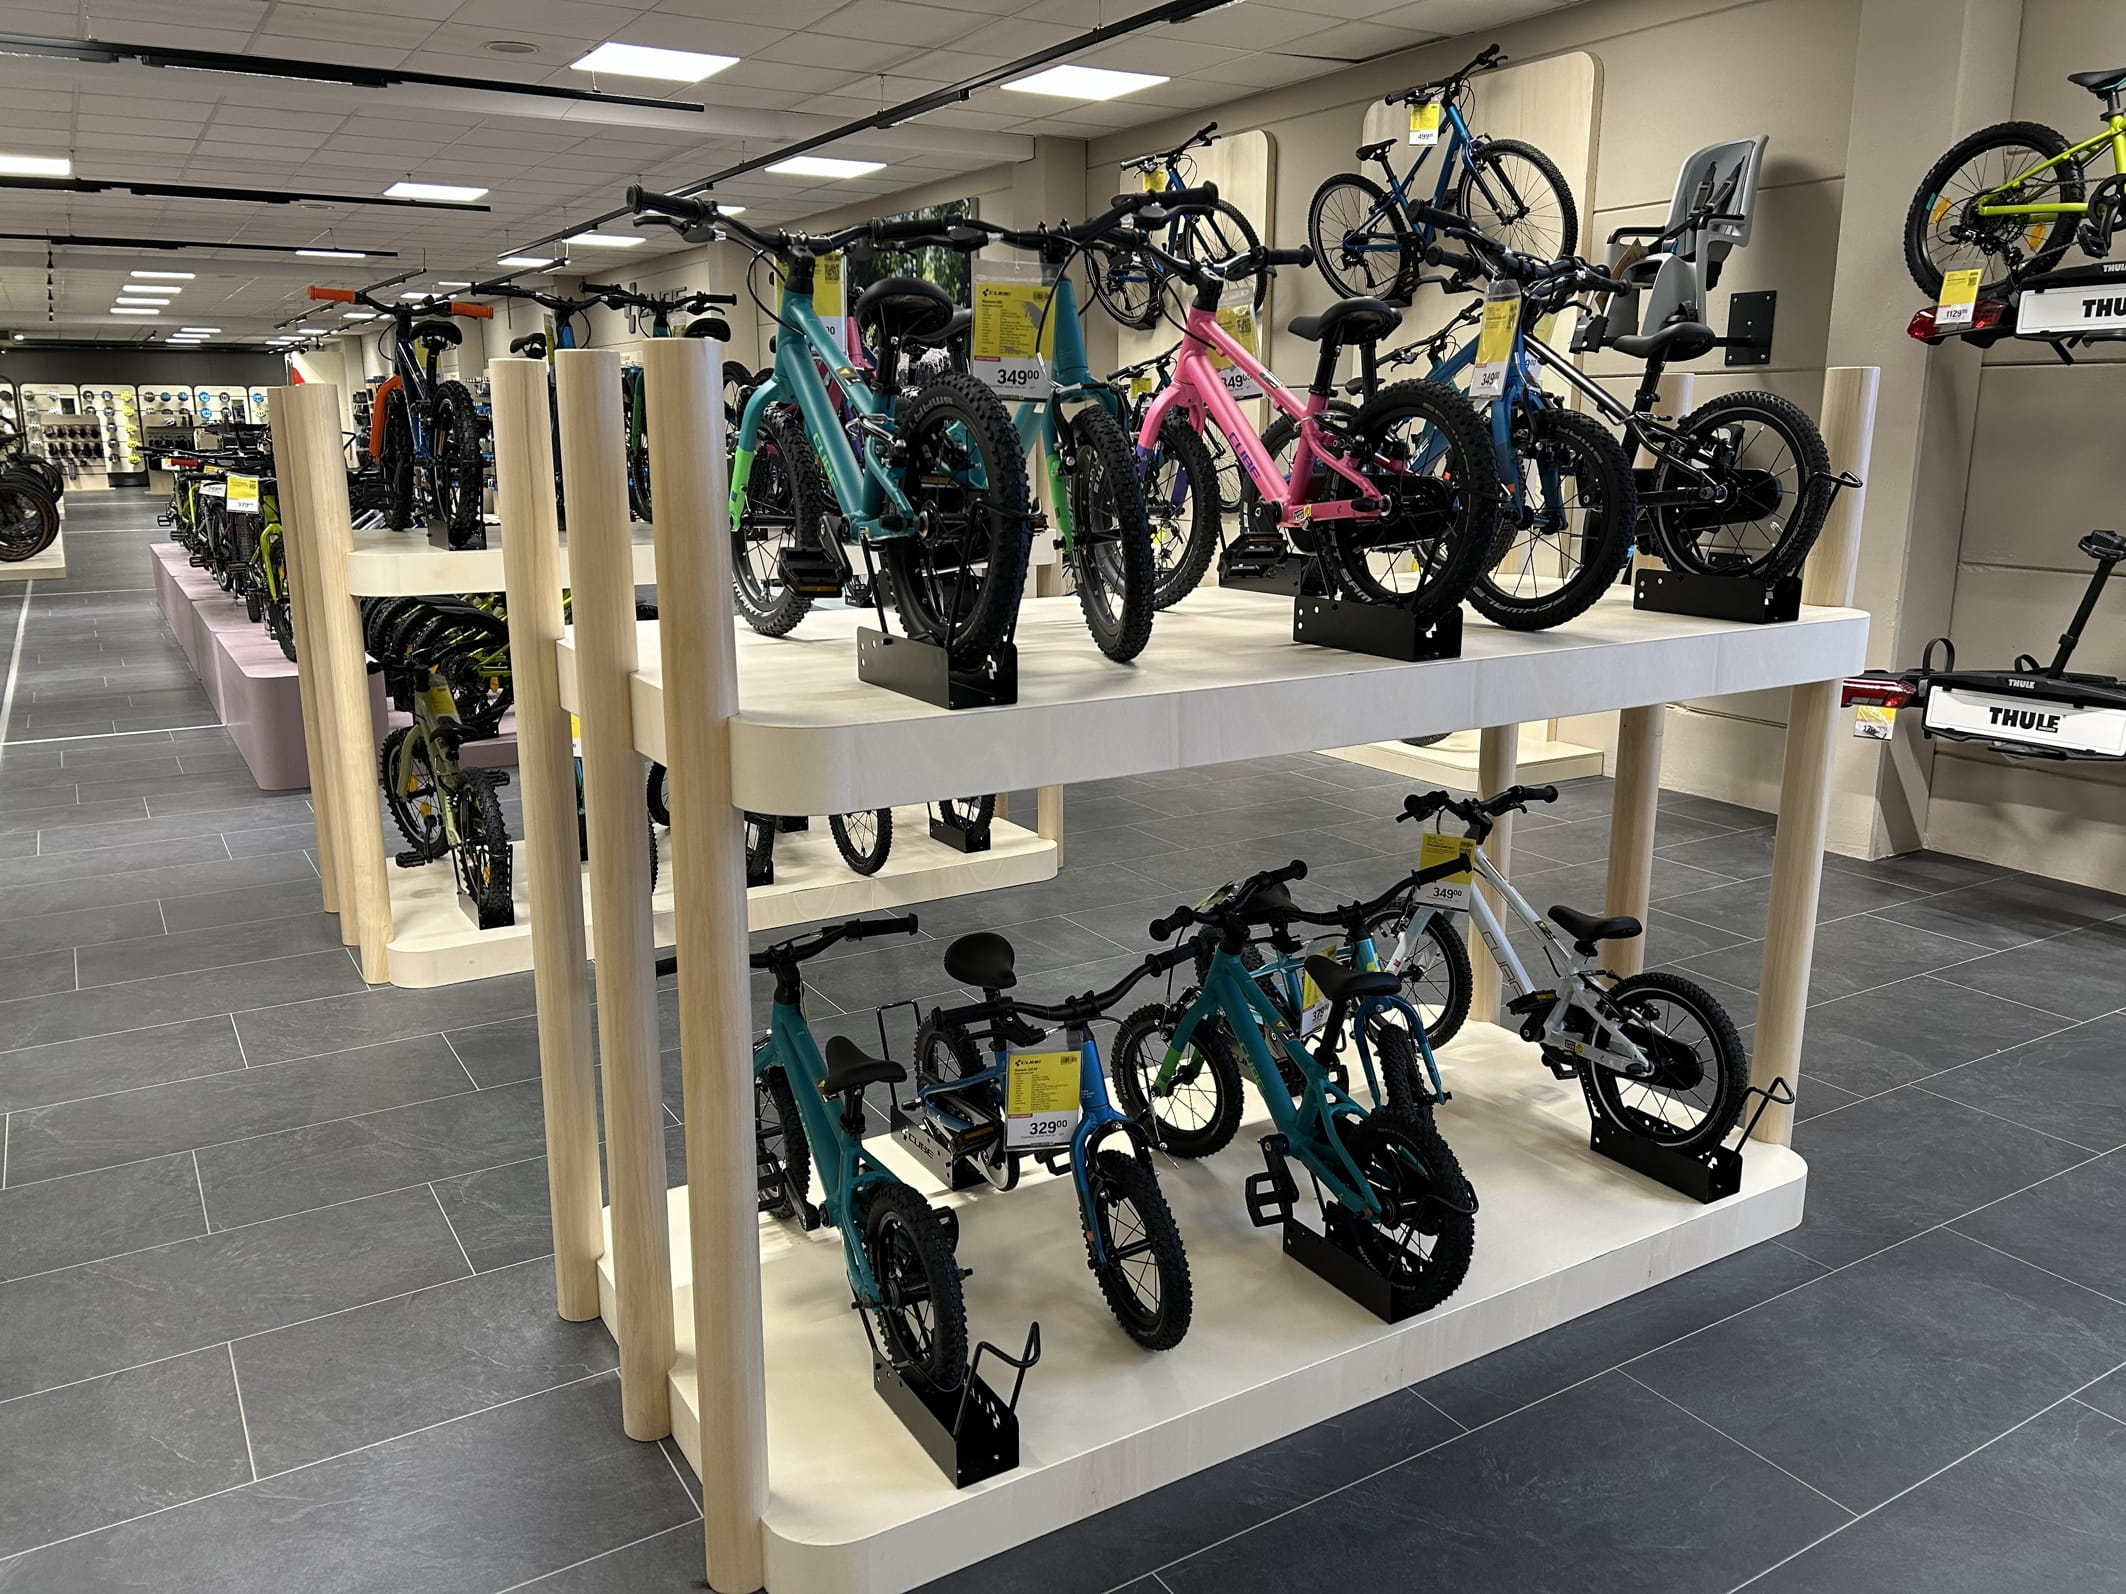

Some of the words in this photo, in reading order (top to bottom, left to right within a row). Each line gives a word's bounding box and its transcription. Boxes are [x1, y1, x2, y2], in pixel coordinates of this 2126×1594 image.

[2103, 263, 2126, 273] THUL
[2082, 297, 2126, 319] THU
[1228, 432, 1261, 479] CUBE
[2008, 678, 2036, 689] THULE
[1989, 706, 2060, 733] THULE
[908, 1132, 934, 1160] CUBE
